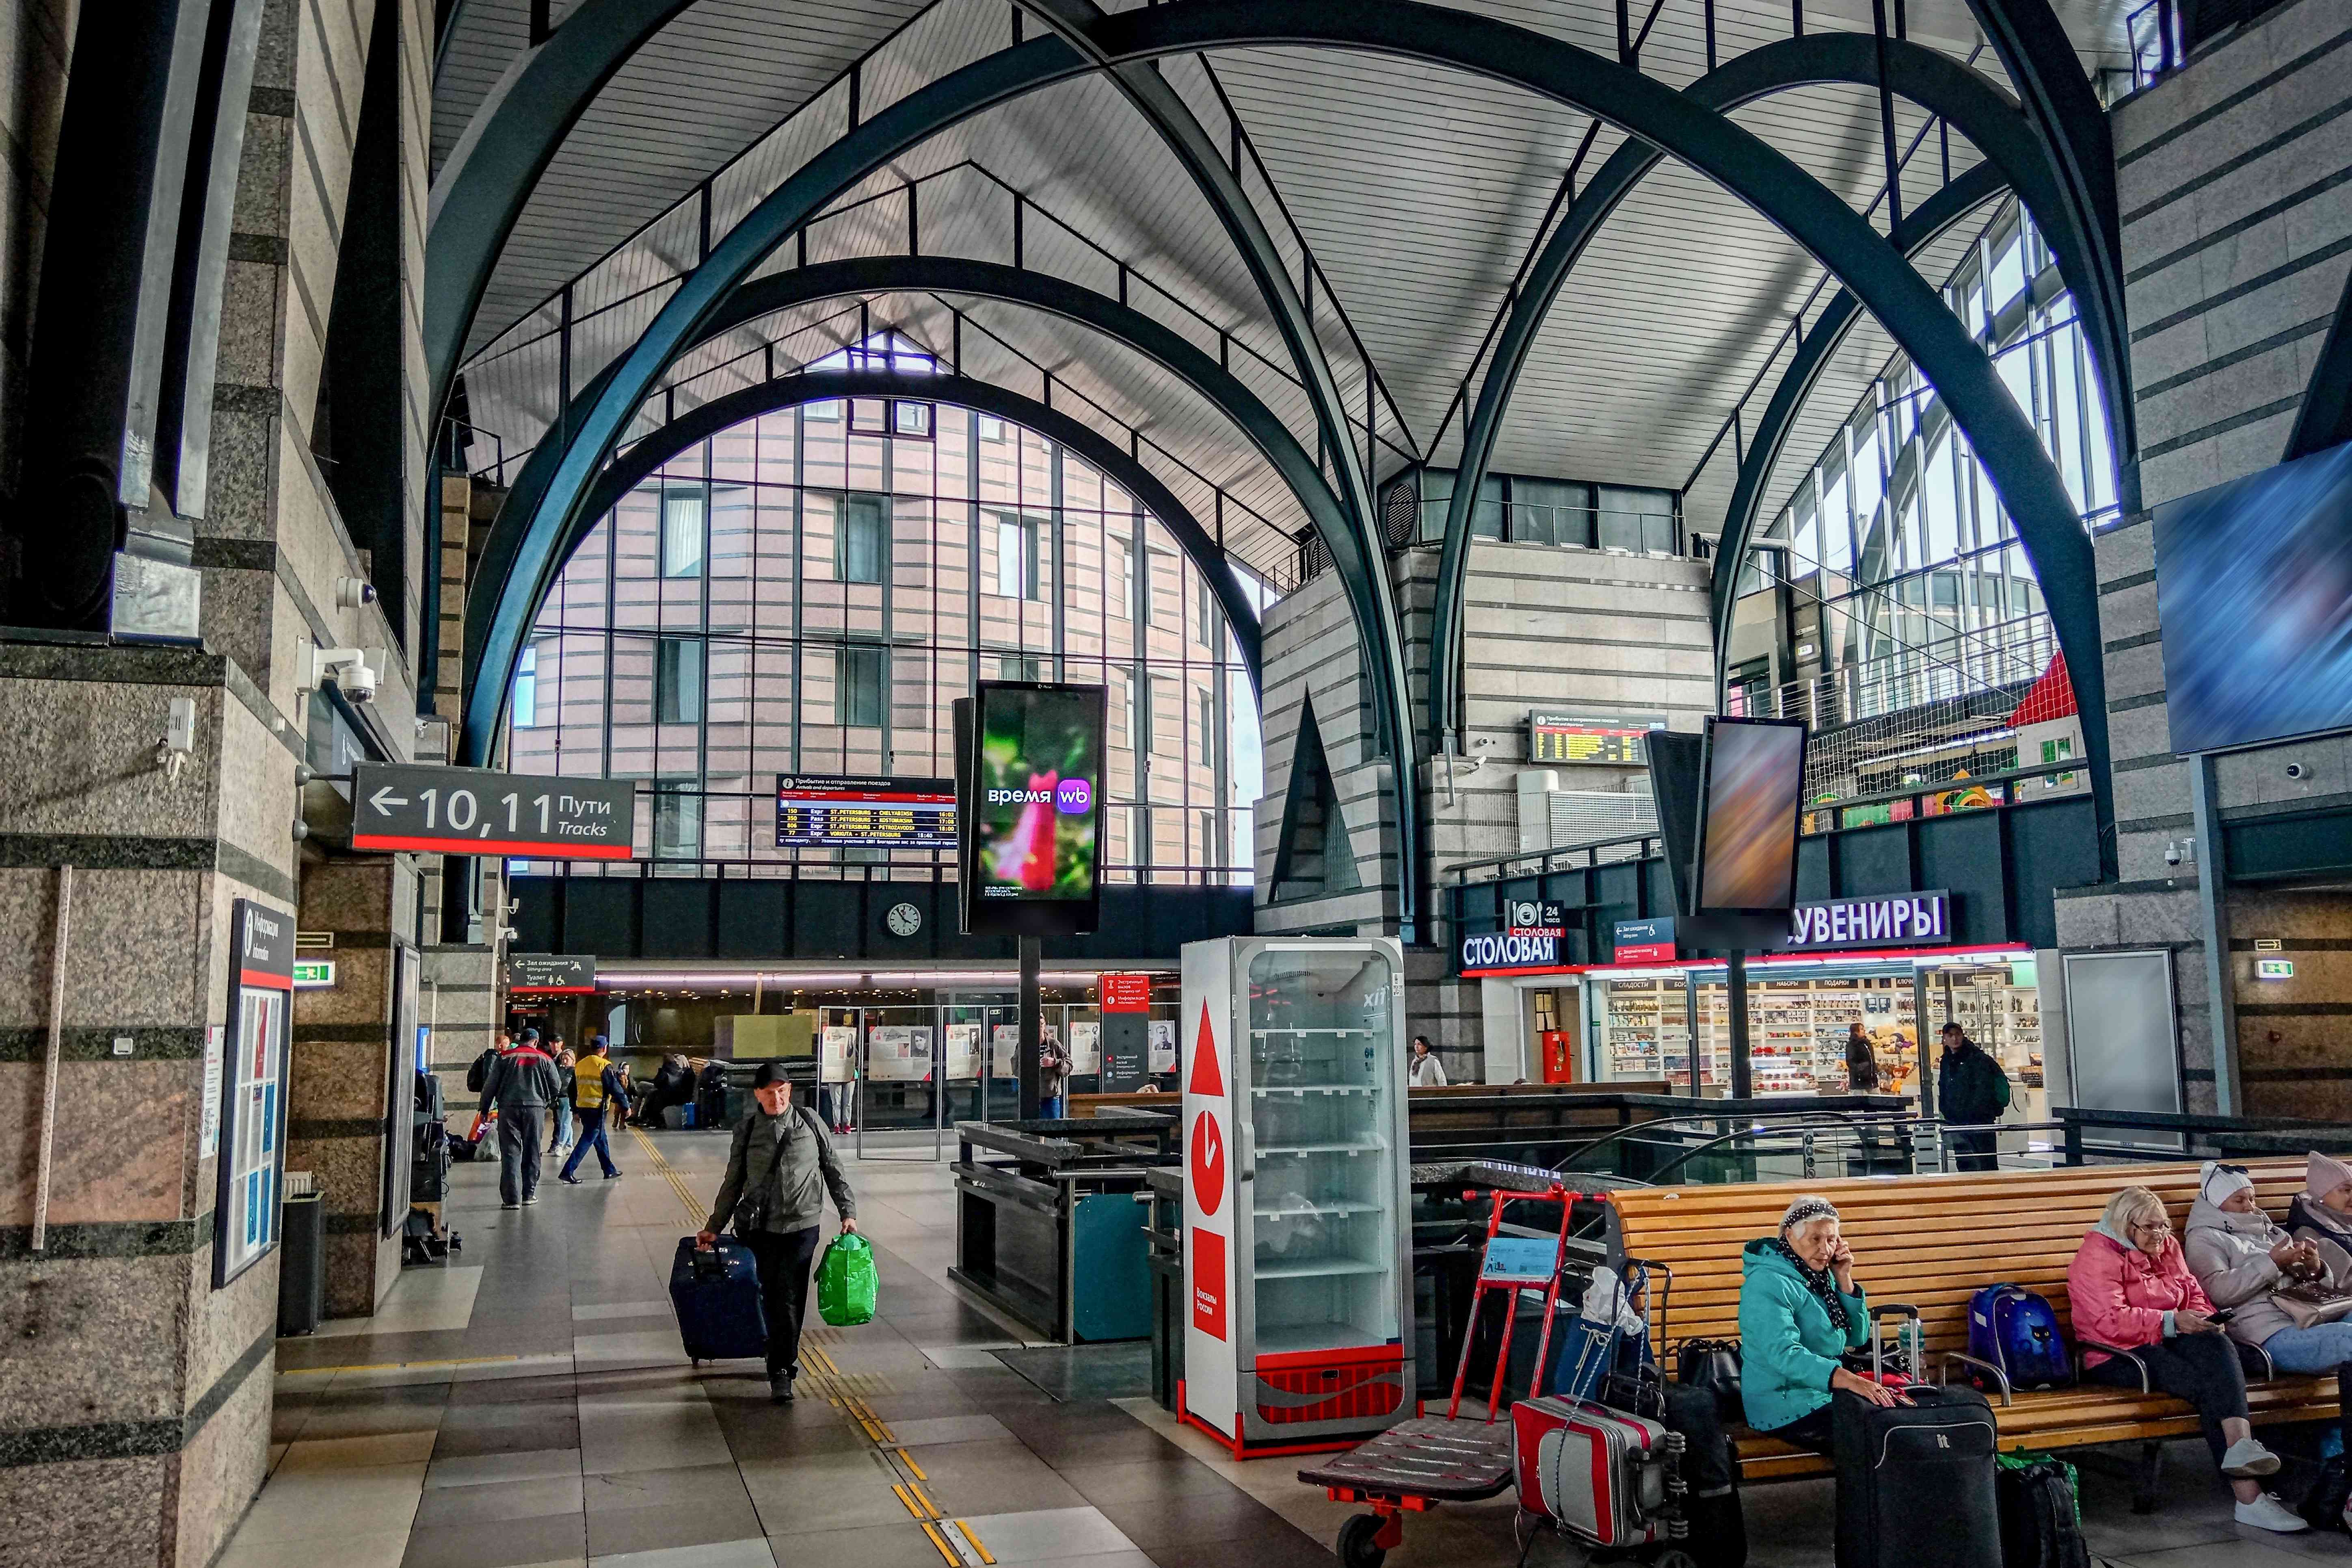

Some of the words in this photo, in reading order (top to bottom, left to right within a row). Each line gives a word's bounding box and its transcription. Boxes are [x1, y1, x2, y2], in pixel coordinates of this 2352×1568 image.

[559, 795, 611, 815] Пути
[988, 789, 1051, 806] время
[1059, 787, 1088, 803] wb
[419, 788, 549, 838] 10,11
[558, 821, 607, 836] Tracks
[1546, 907, 1558, 916] 24
[1788, 896, 1941, 945] УВЕНИРЫ
[1513, 928, 1561, 936] СТОЛОВАЯ
[1464, 936, 1554, 965] СТОЛОВАЯ
[1197, 1287, 1217, 1305] Вокзалы
[1197, 1299, 1213, 1316] России
[1936, 1434, 1950, 1448] it
